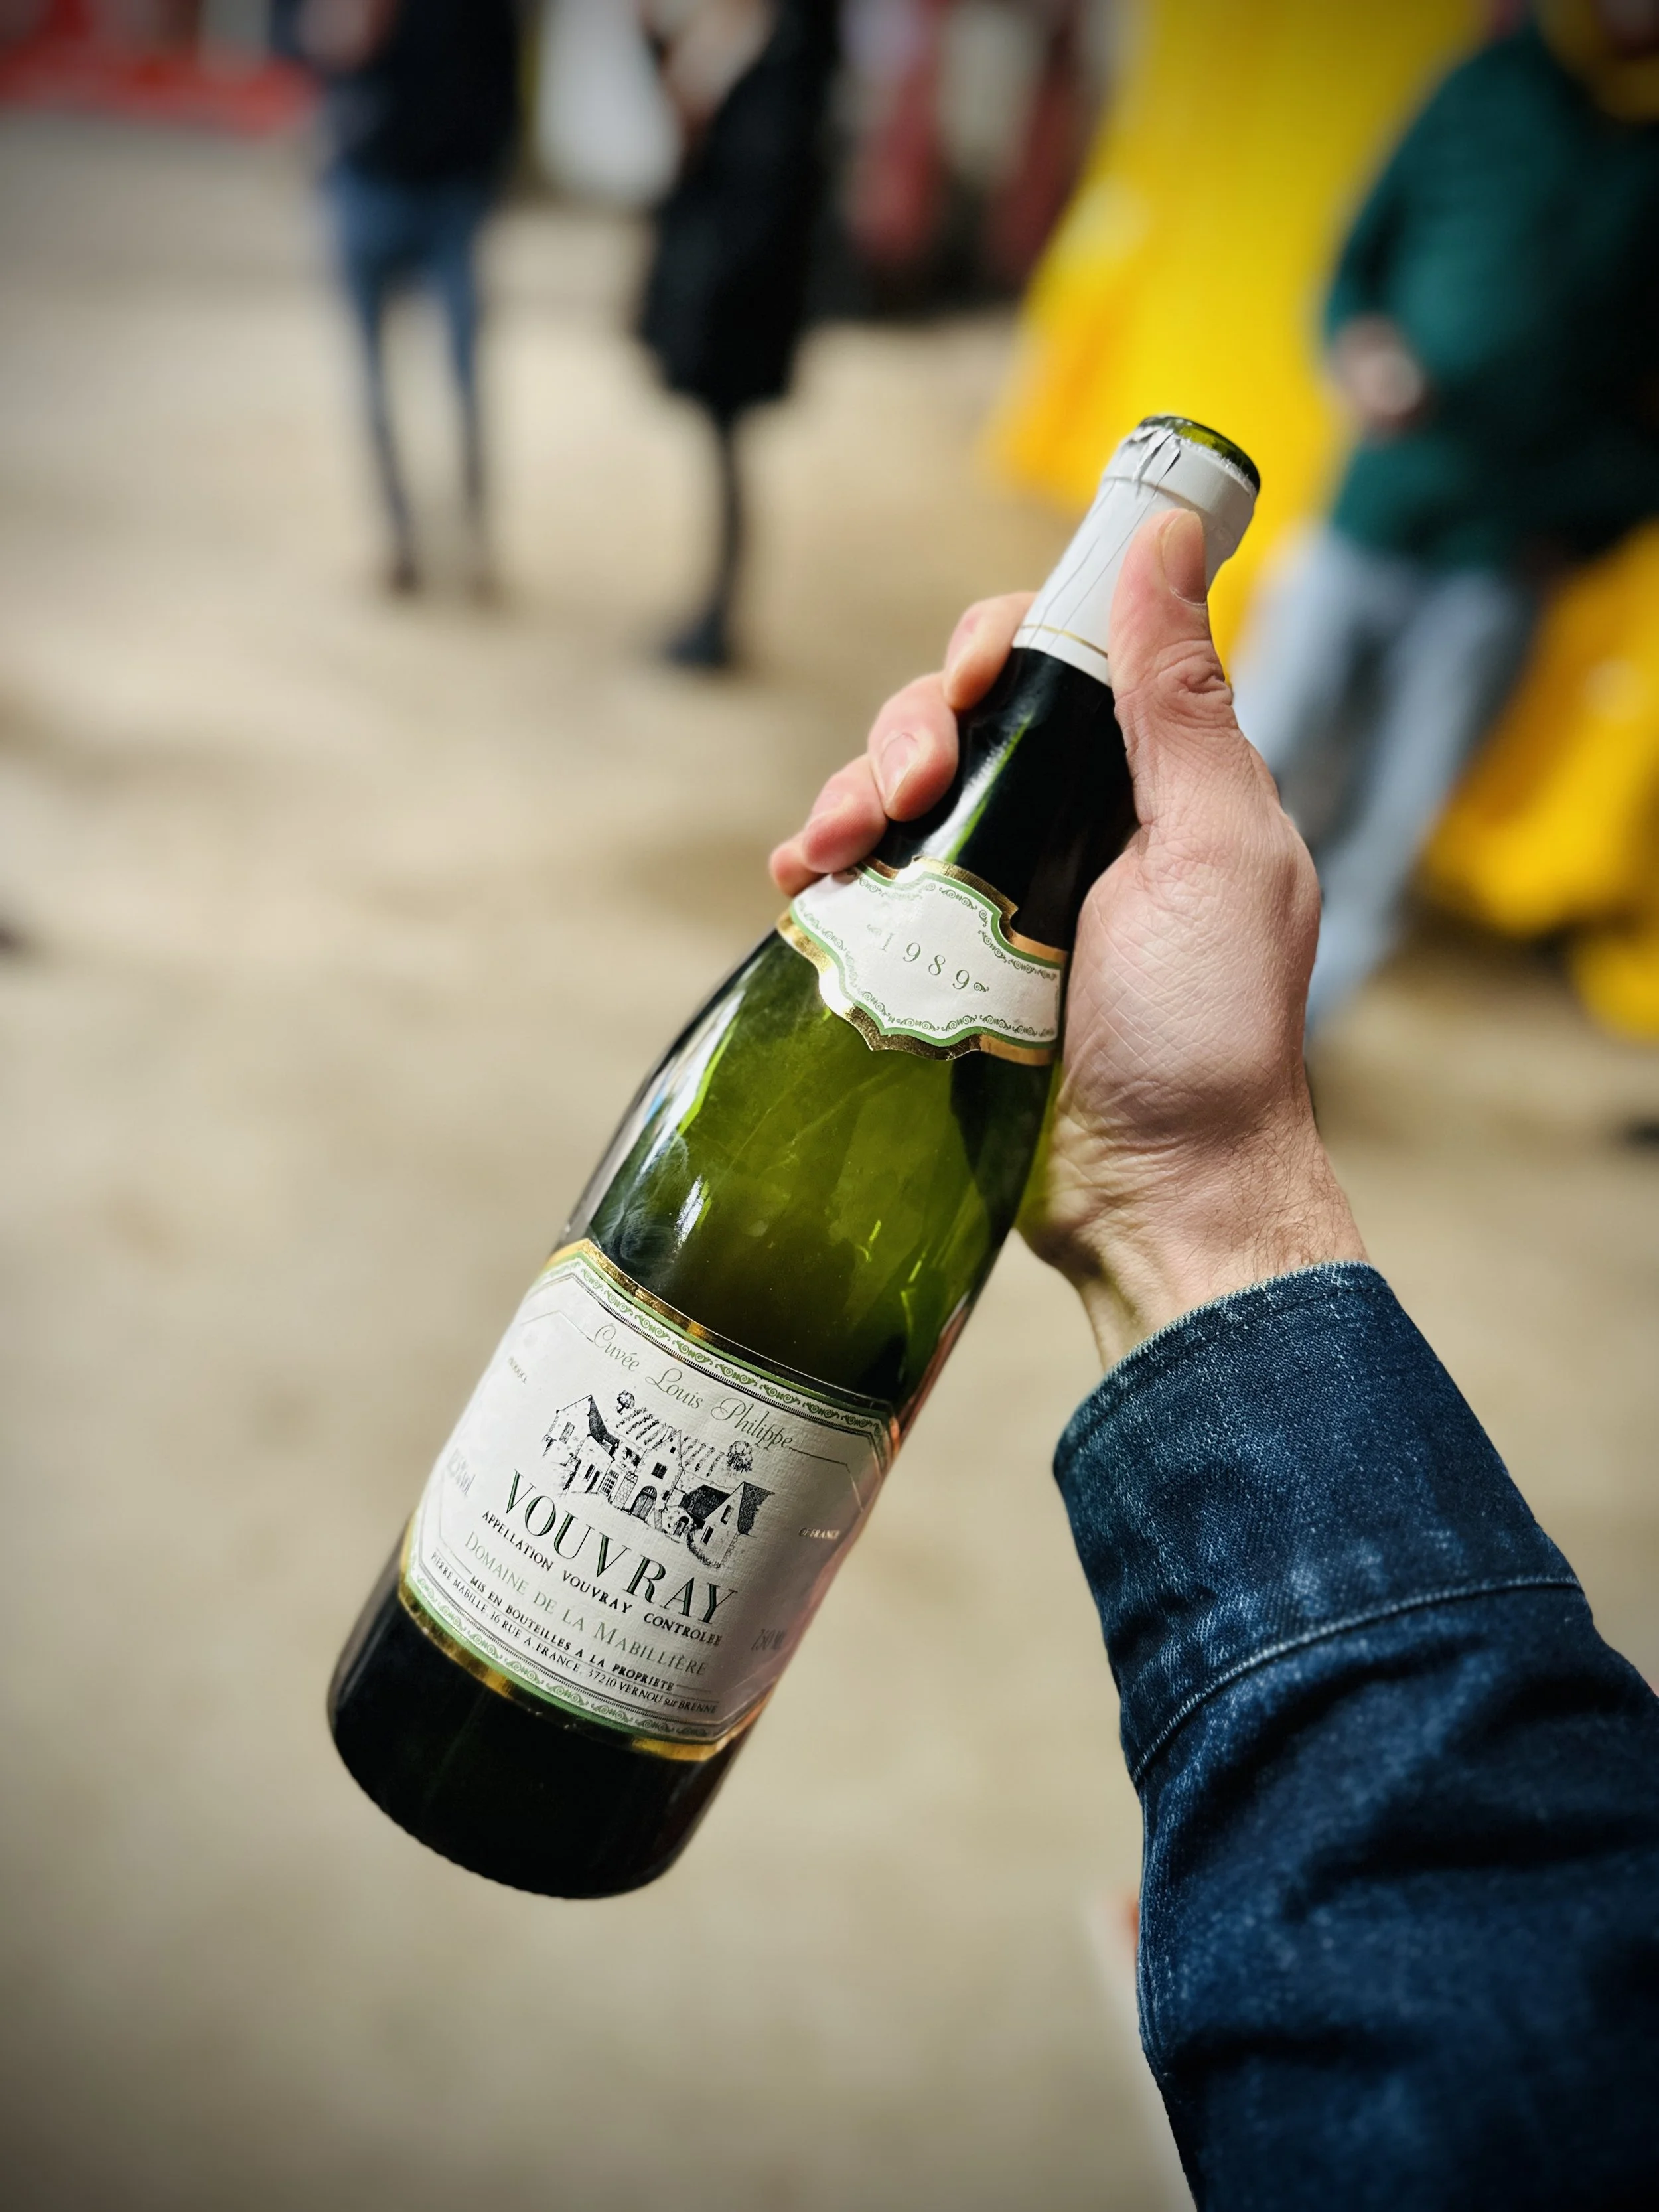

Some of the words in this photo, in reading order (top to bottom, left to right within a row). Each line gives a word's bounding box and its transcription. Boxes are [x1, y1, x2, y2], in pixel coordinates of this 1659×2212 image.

[881, 932, 970, 990] 1989
[594, 1323, 640, 1372] Cuvée
[645, 1368, 704, 1409] Louis
[711, 1397, 793, 1451] Philippe
[465, 1531, 529, 1595] DOMAINE
[533, 1591, 557, 1615] DE
[562, 1609, 585, 1631] LA
[594, 1621, 709, 1676] MABILLIÈRE
[482, 1510, 554, 1572] APPELLATION
[562, 1570, 632, 1614] VOUVRAY
[644, 1613, 723, 1647] CONTROLEE
[506, 1469, 738, 1625] VOUVRAY
[431, 1551, 454, 1581] PIERRE
[490, 1611, 501, 1624] 16
[501, 1620, 522, 1639] RUE
[589, 1668, 617, 1688] 37210
[620, 1681, 662, 1704] VERNOU
[664, 1698, 678, 1707] sur
[678, 1700, 718, 1714] BRENNE
[470, 1576, 486, 1593] MIS
[488, 1591, 503, 1607] EN
[506, 1604, 571, 1651] BOUTEILLES
[575, 1649, 583, 1658] A
[589, 1654, 605, 1668] LA
[612, 1663, 674, 1692] PROPRIETE
